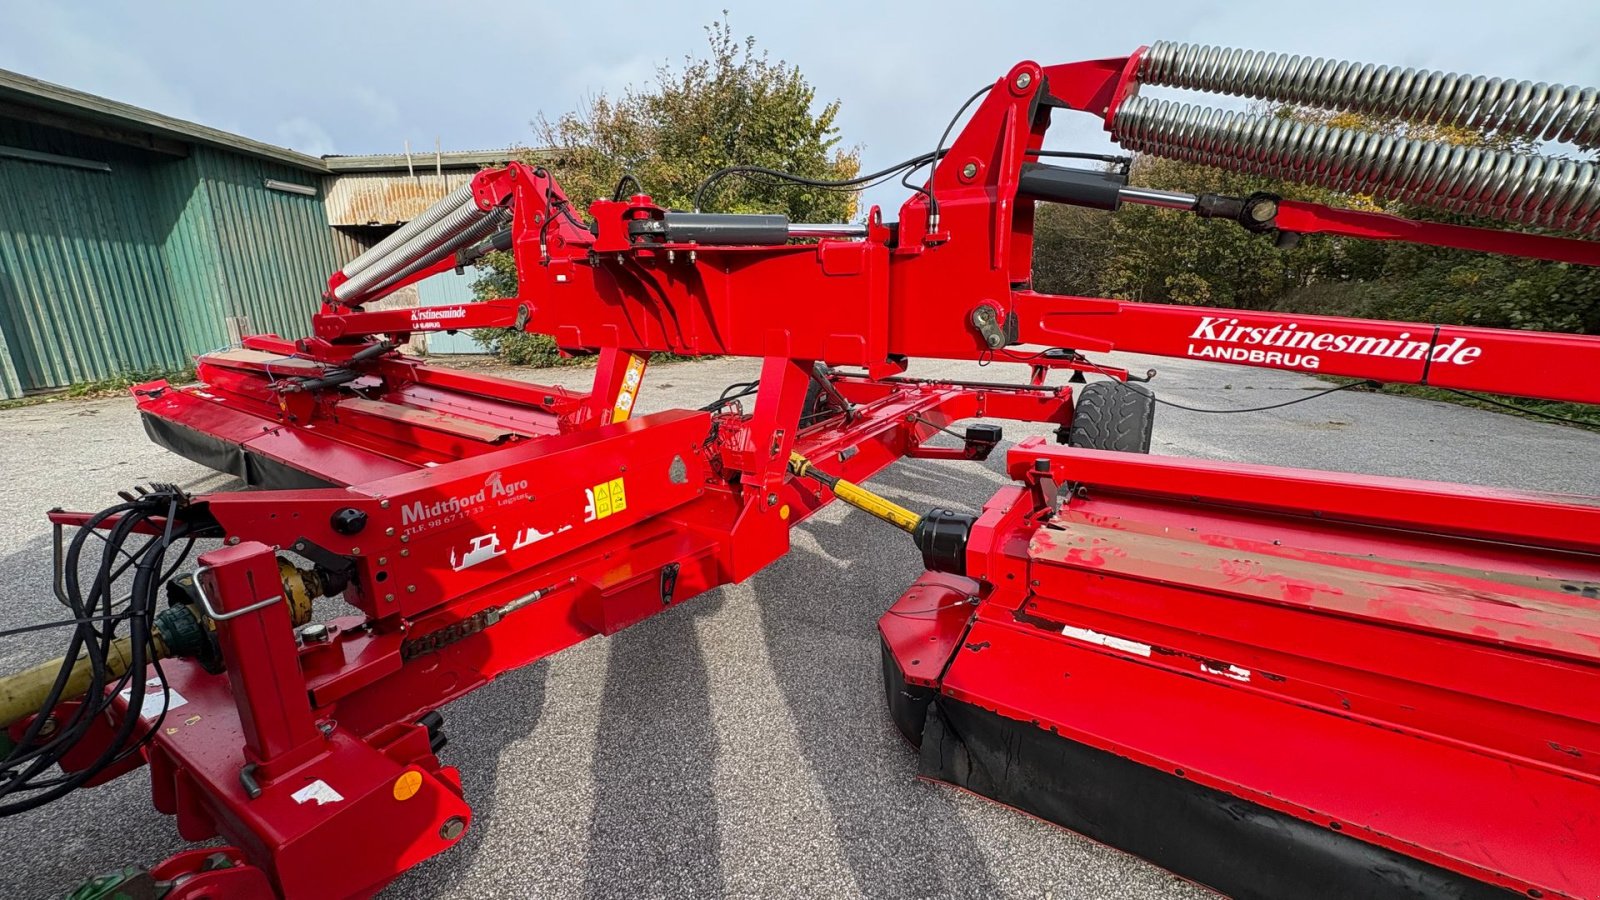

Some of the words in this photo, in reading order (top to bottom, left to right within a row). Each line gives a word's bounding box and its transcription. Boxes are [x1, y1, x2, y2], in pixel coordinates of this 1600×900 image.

[411, 306, 466, 321] Kirstinesminde
[1189, 316, 1482, 366] Kirstinesminde
[1188, 344, 1320, 369] LANDBRUG
[401, 488, 486, 526] Midtfjord
[491, 478, 528, 499] Agro
[428, 519, 442, 529] 98
[443, 513, 456, 524] 67
